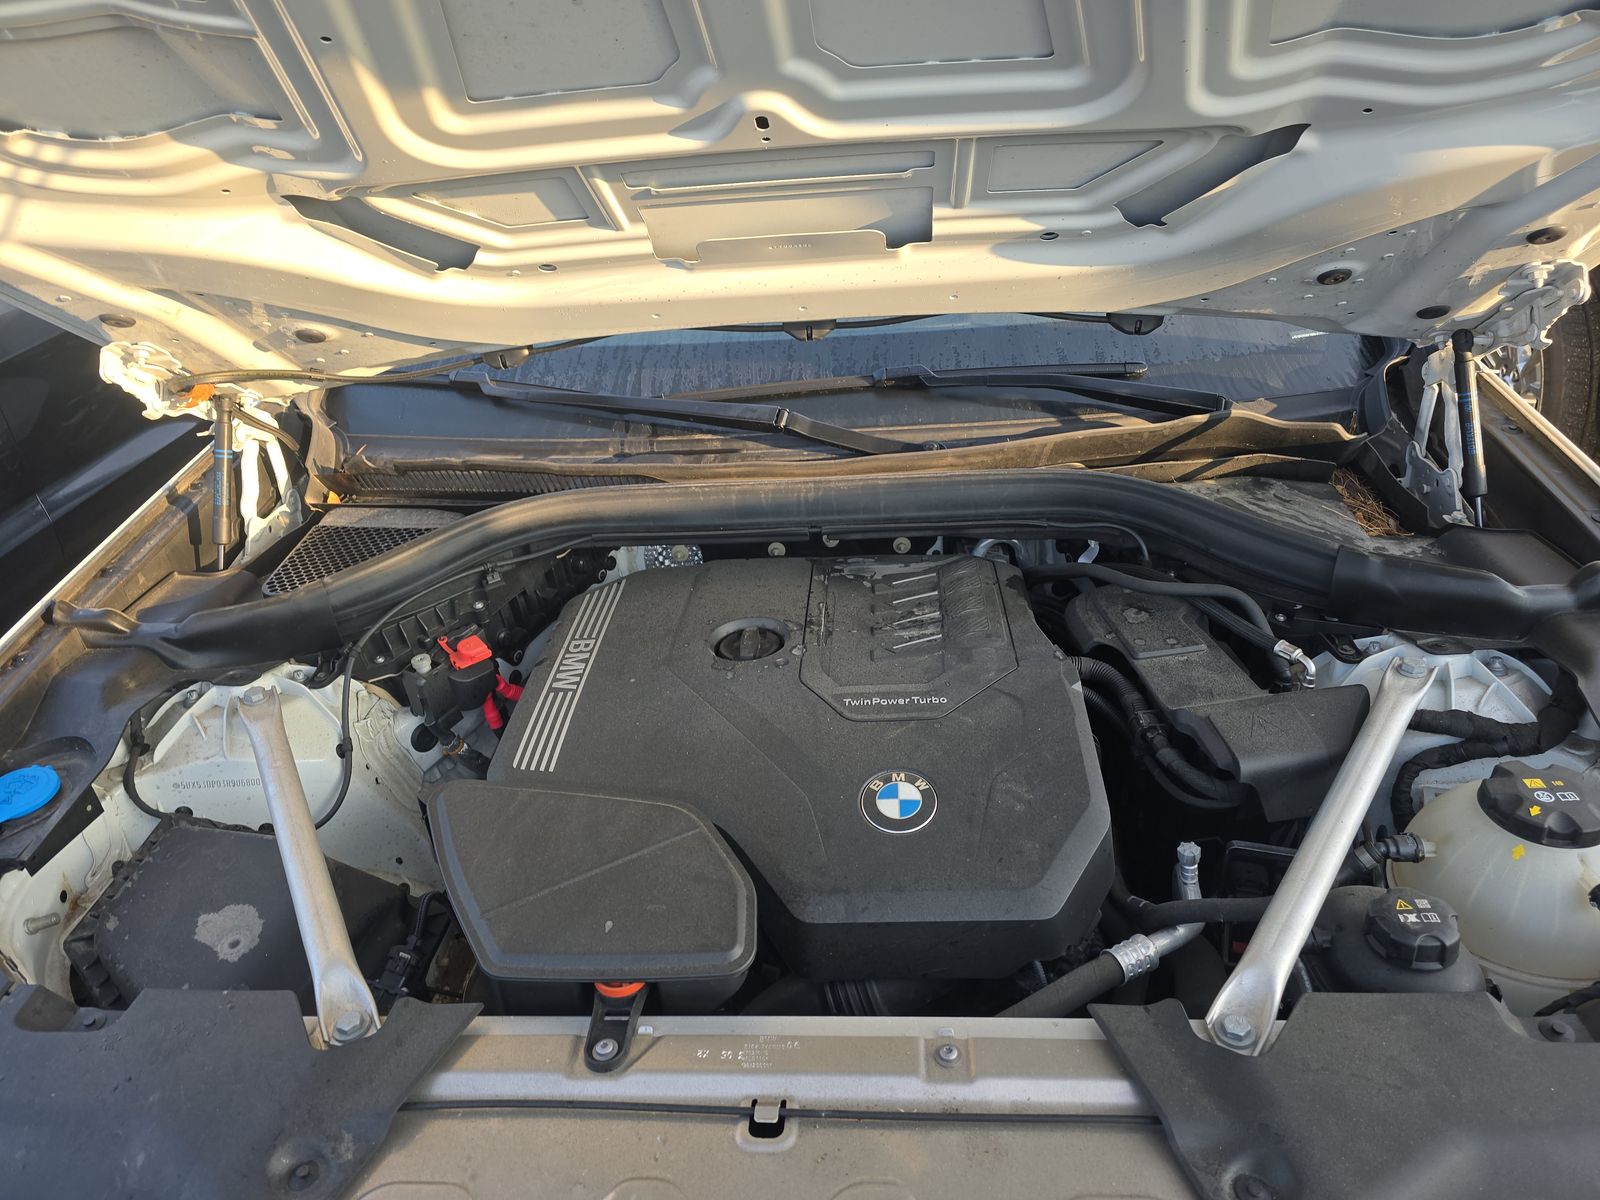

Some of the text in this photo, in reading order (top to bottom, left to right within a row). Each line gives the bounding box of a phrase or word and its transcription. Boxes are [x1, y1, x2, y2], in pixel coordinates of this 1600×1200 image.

[552, 639, 595, 690] BMW
[911, 696, 948, 704] Turbo
[869, 772, 929, 792] BMW
